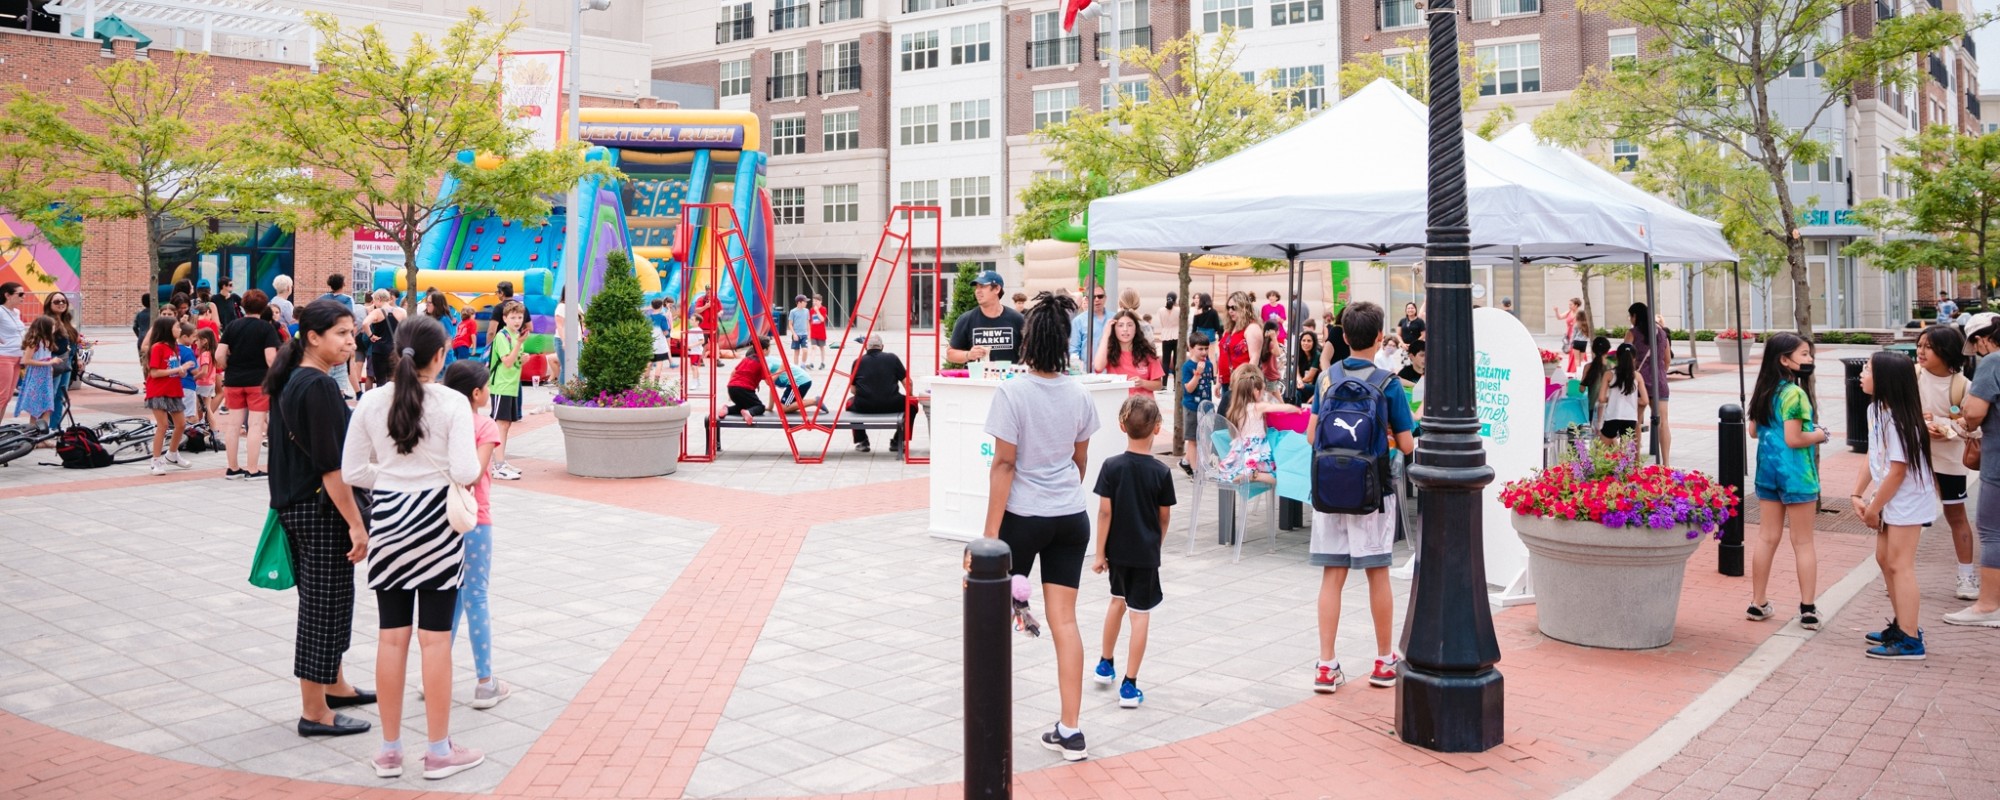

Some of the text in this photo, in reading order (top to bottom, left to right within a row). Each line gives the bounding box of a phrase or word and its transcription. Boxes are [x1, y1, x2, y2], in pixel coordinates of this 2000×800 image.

[579, 125, 735, 142] VERTICAL RUSH
[982, 329, 1003, 337] NEW
[974, 336, 1011, 345] MARKET
[1475, 366, 1511, 381] CREATIVE
